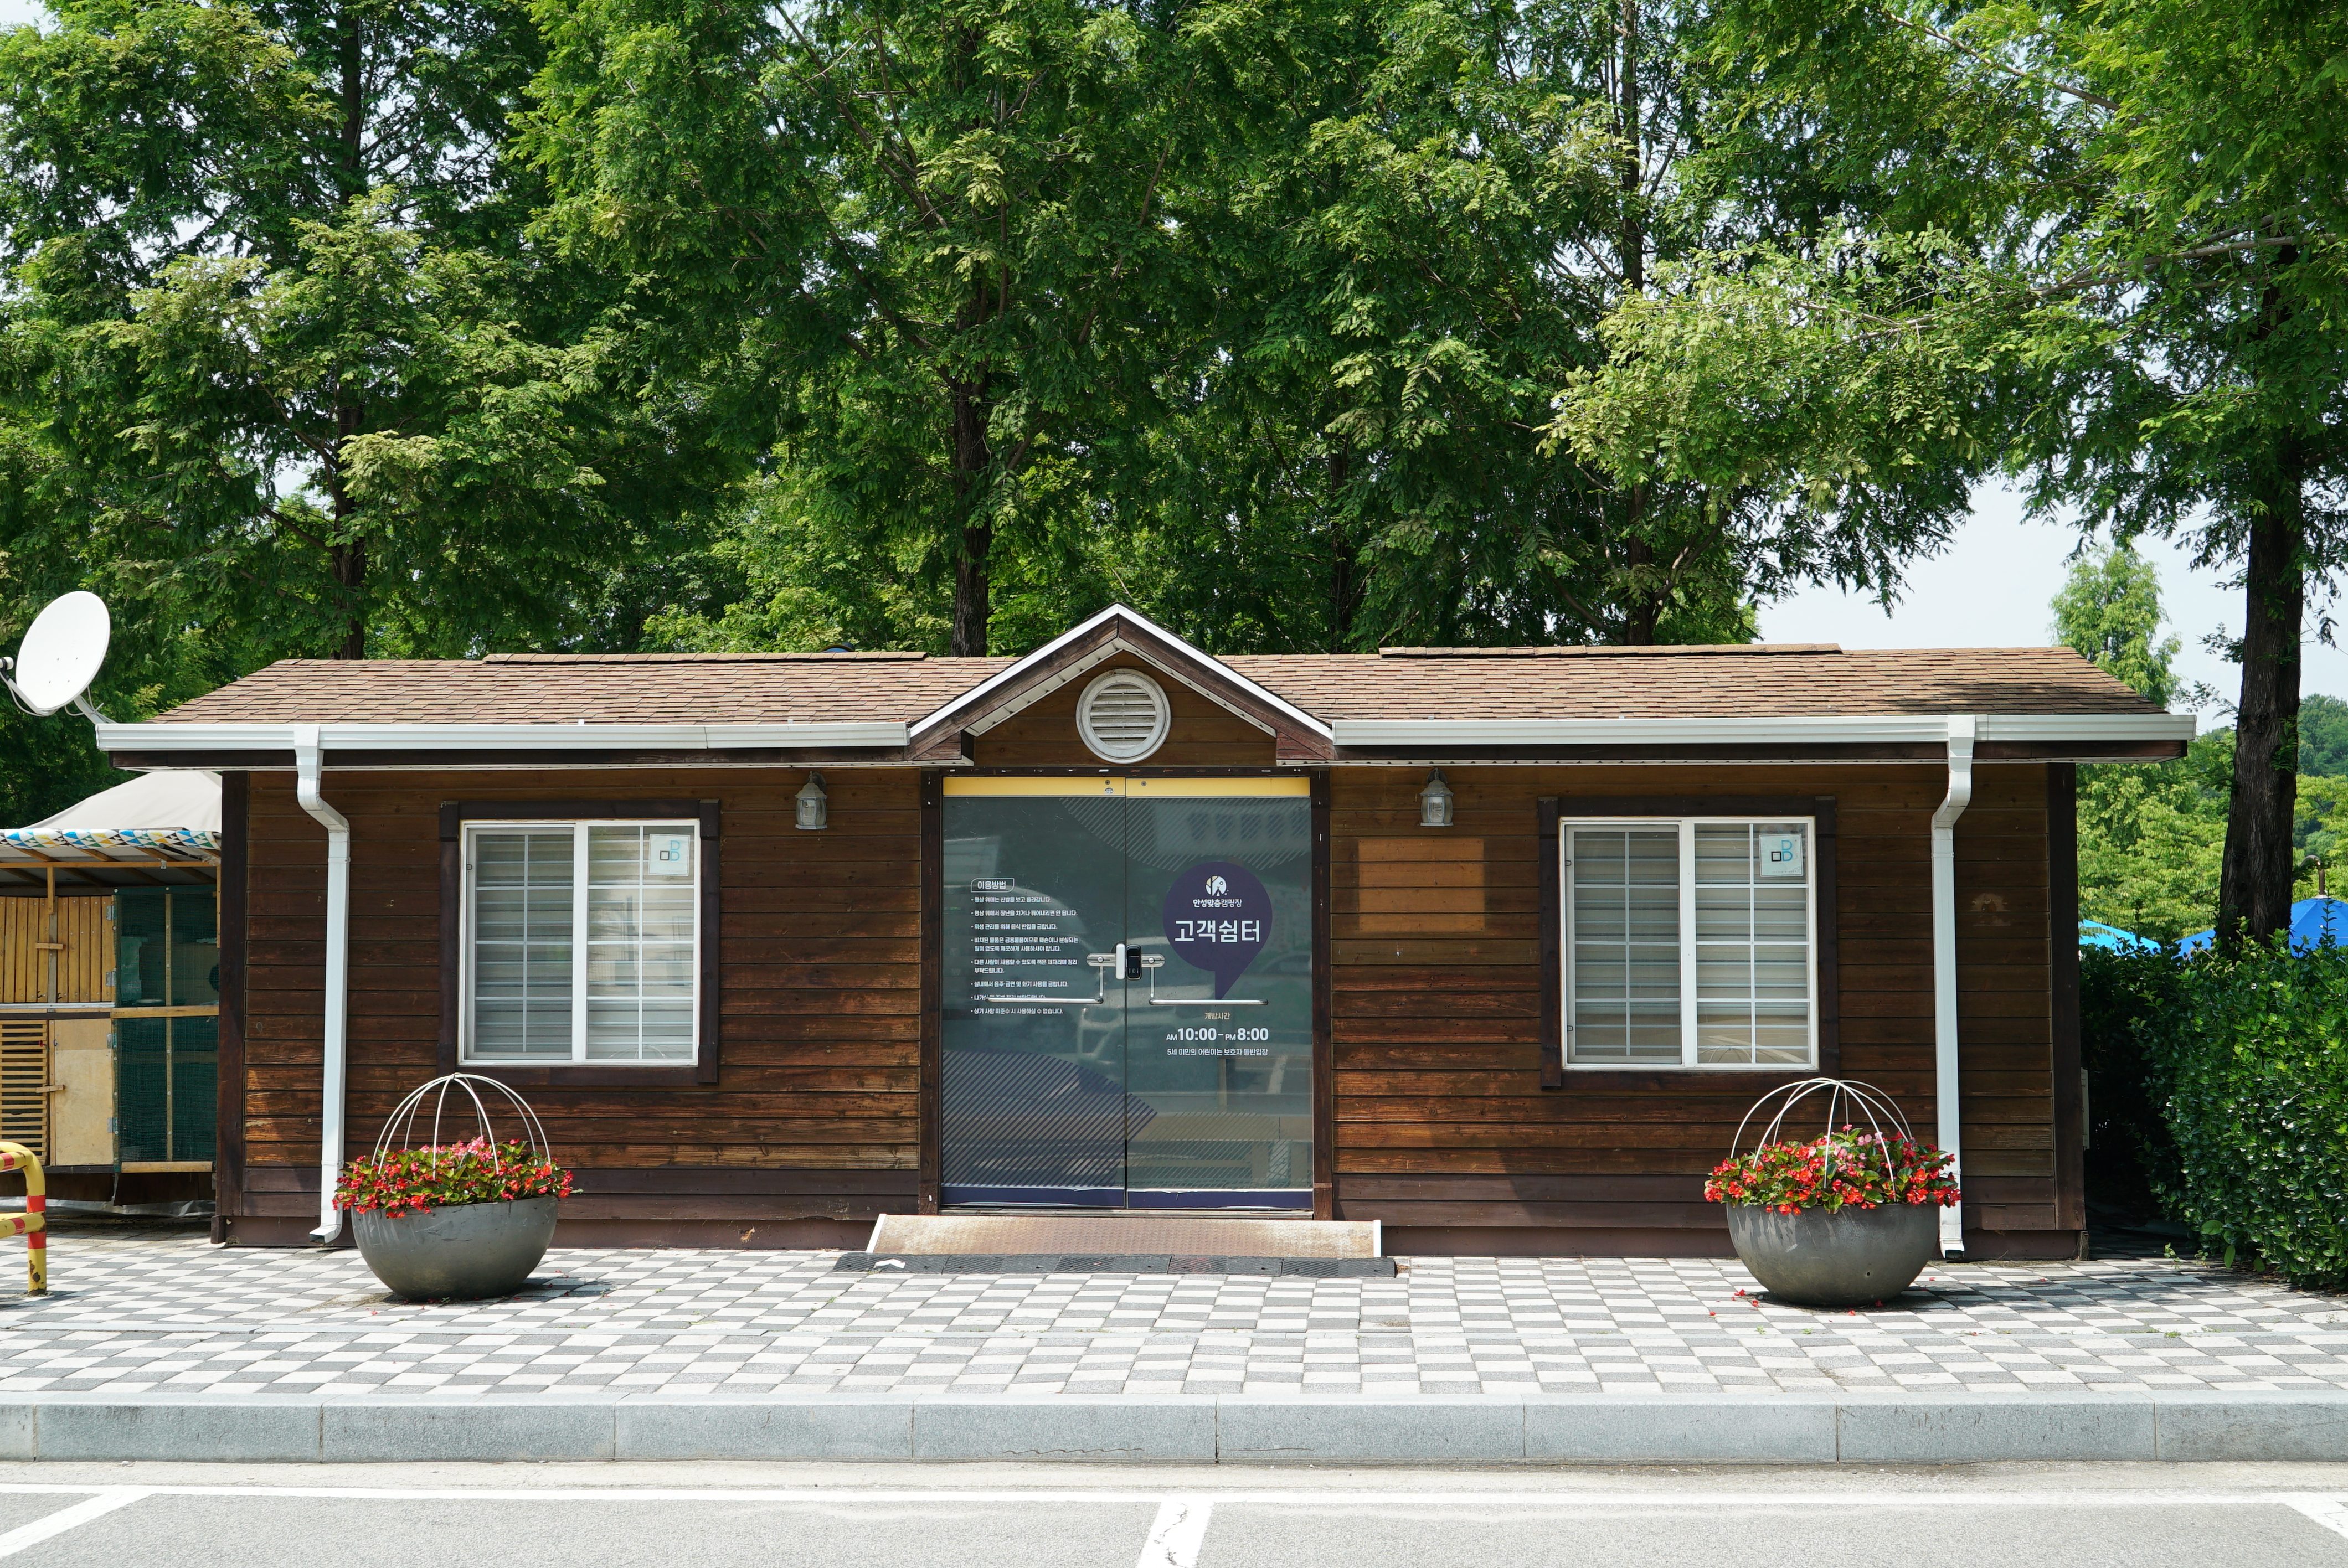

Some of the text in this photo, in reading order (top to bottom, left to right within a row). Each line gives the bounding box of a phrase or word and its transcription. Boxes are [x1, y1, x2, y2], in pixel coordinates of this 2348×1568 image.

[977, 880, 1007, 890] 이용방법
[1192, 899, 1243, 908] 안성맞춤캠핑장
[1175, 920, 1260, 943] 고객쉼터
[1204, 1012, 1231, 1020] 개방시간
